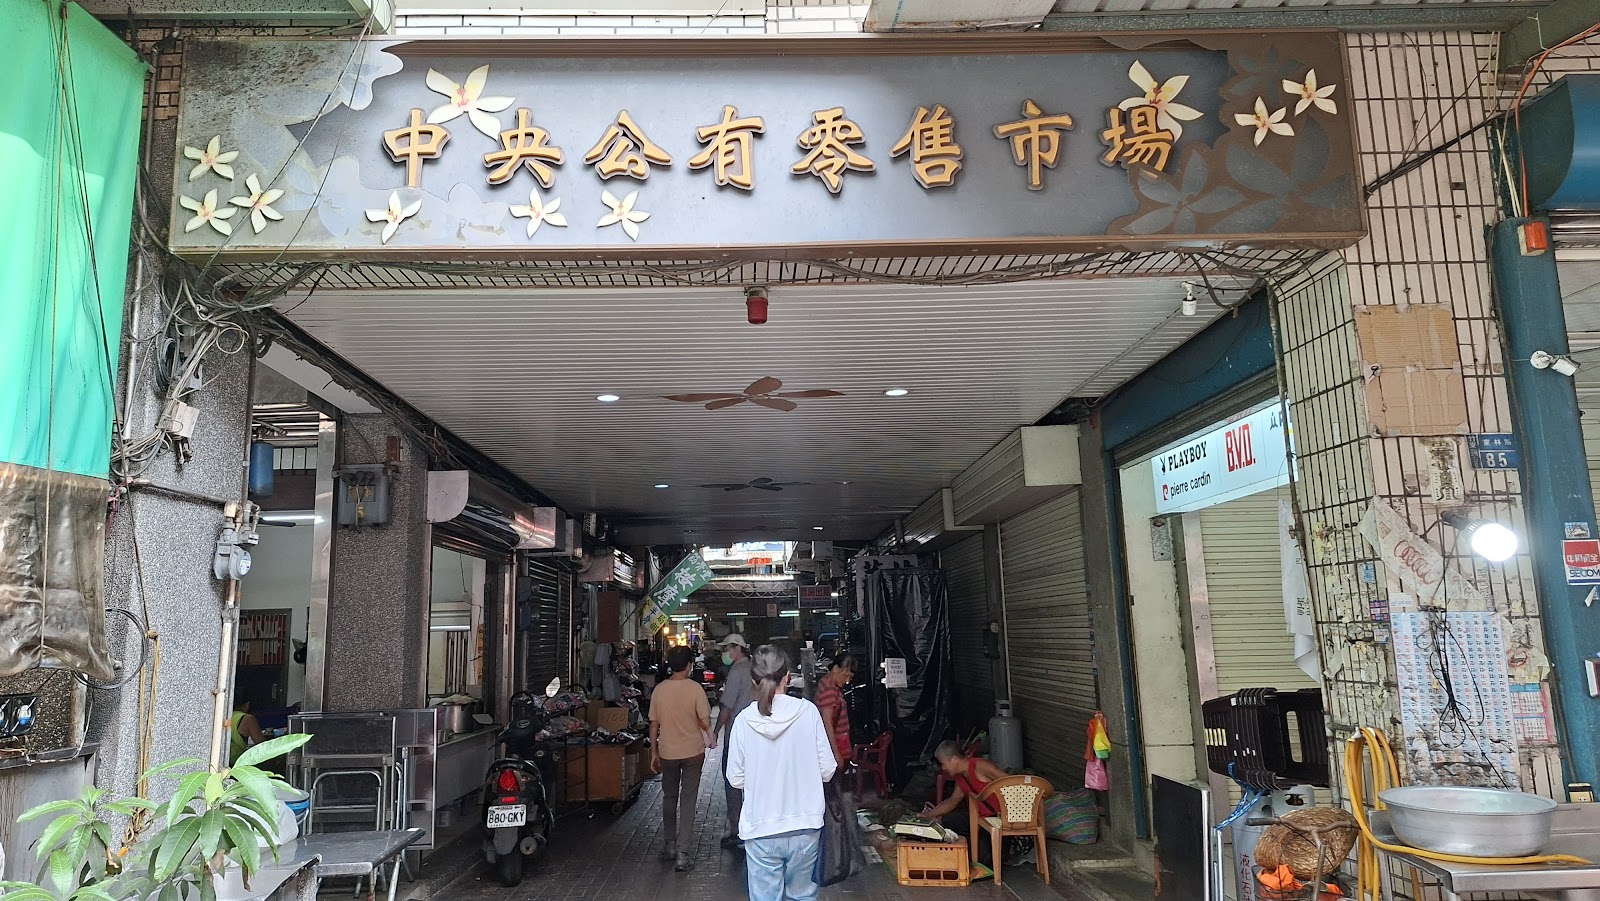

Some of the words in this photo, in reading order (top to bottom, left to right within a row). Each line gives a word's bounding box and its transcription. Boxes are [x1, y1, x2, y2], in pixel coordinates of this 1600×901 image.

[382, 99, 1176, 193] 中央公有零售市場
[1168, 441, 1207, 471] PLAYBOY
[1486, 453, 1507, 467] 85
[1170, 480, 1188, 499] pierre
[1189, 471, 1211, 490] cardin
[653, 567, 696, 608] 按摩
[1570, 569, 1600, 577] SECOM
